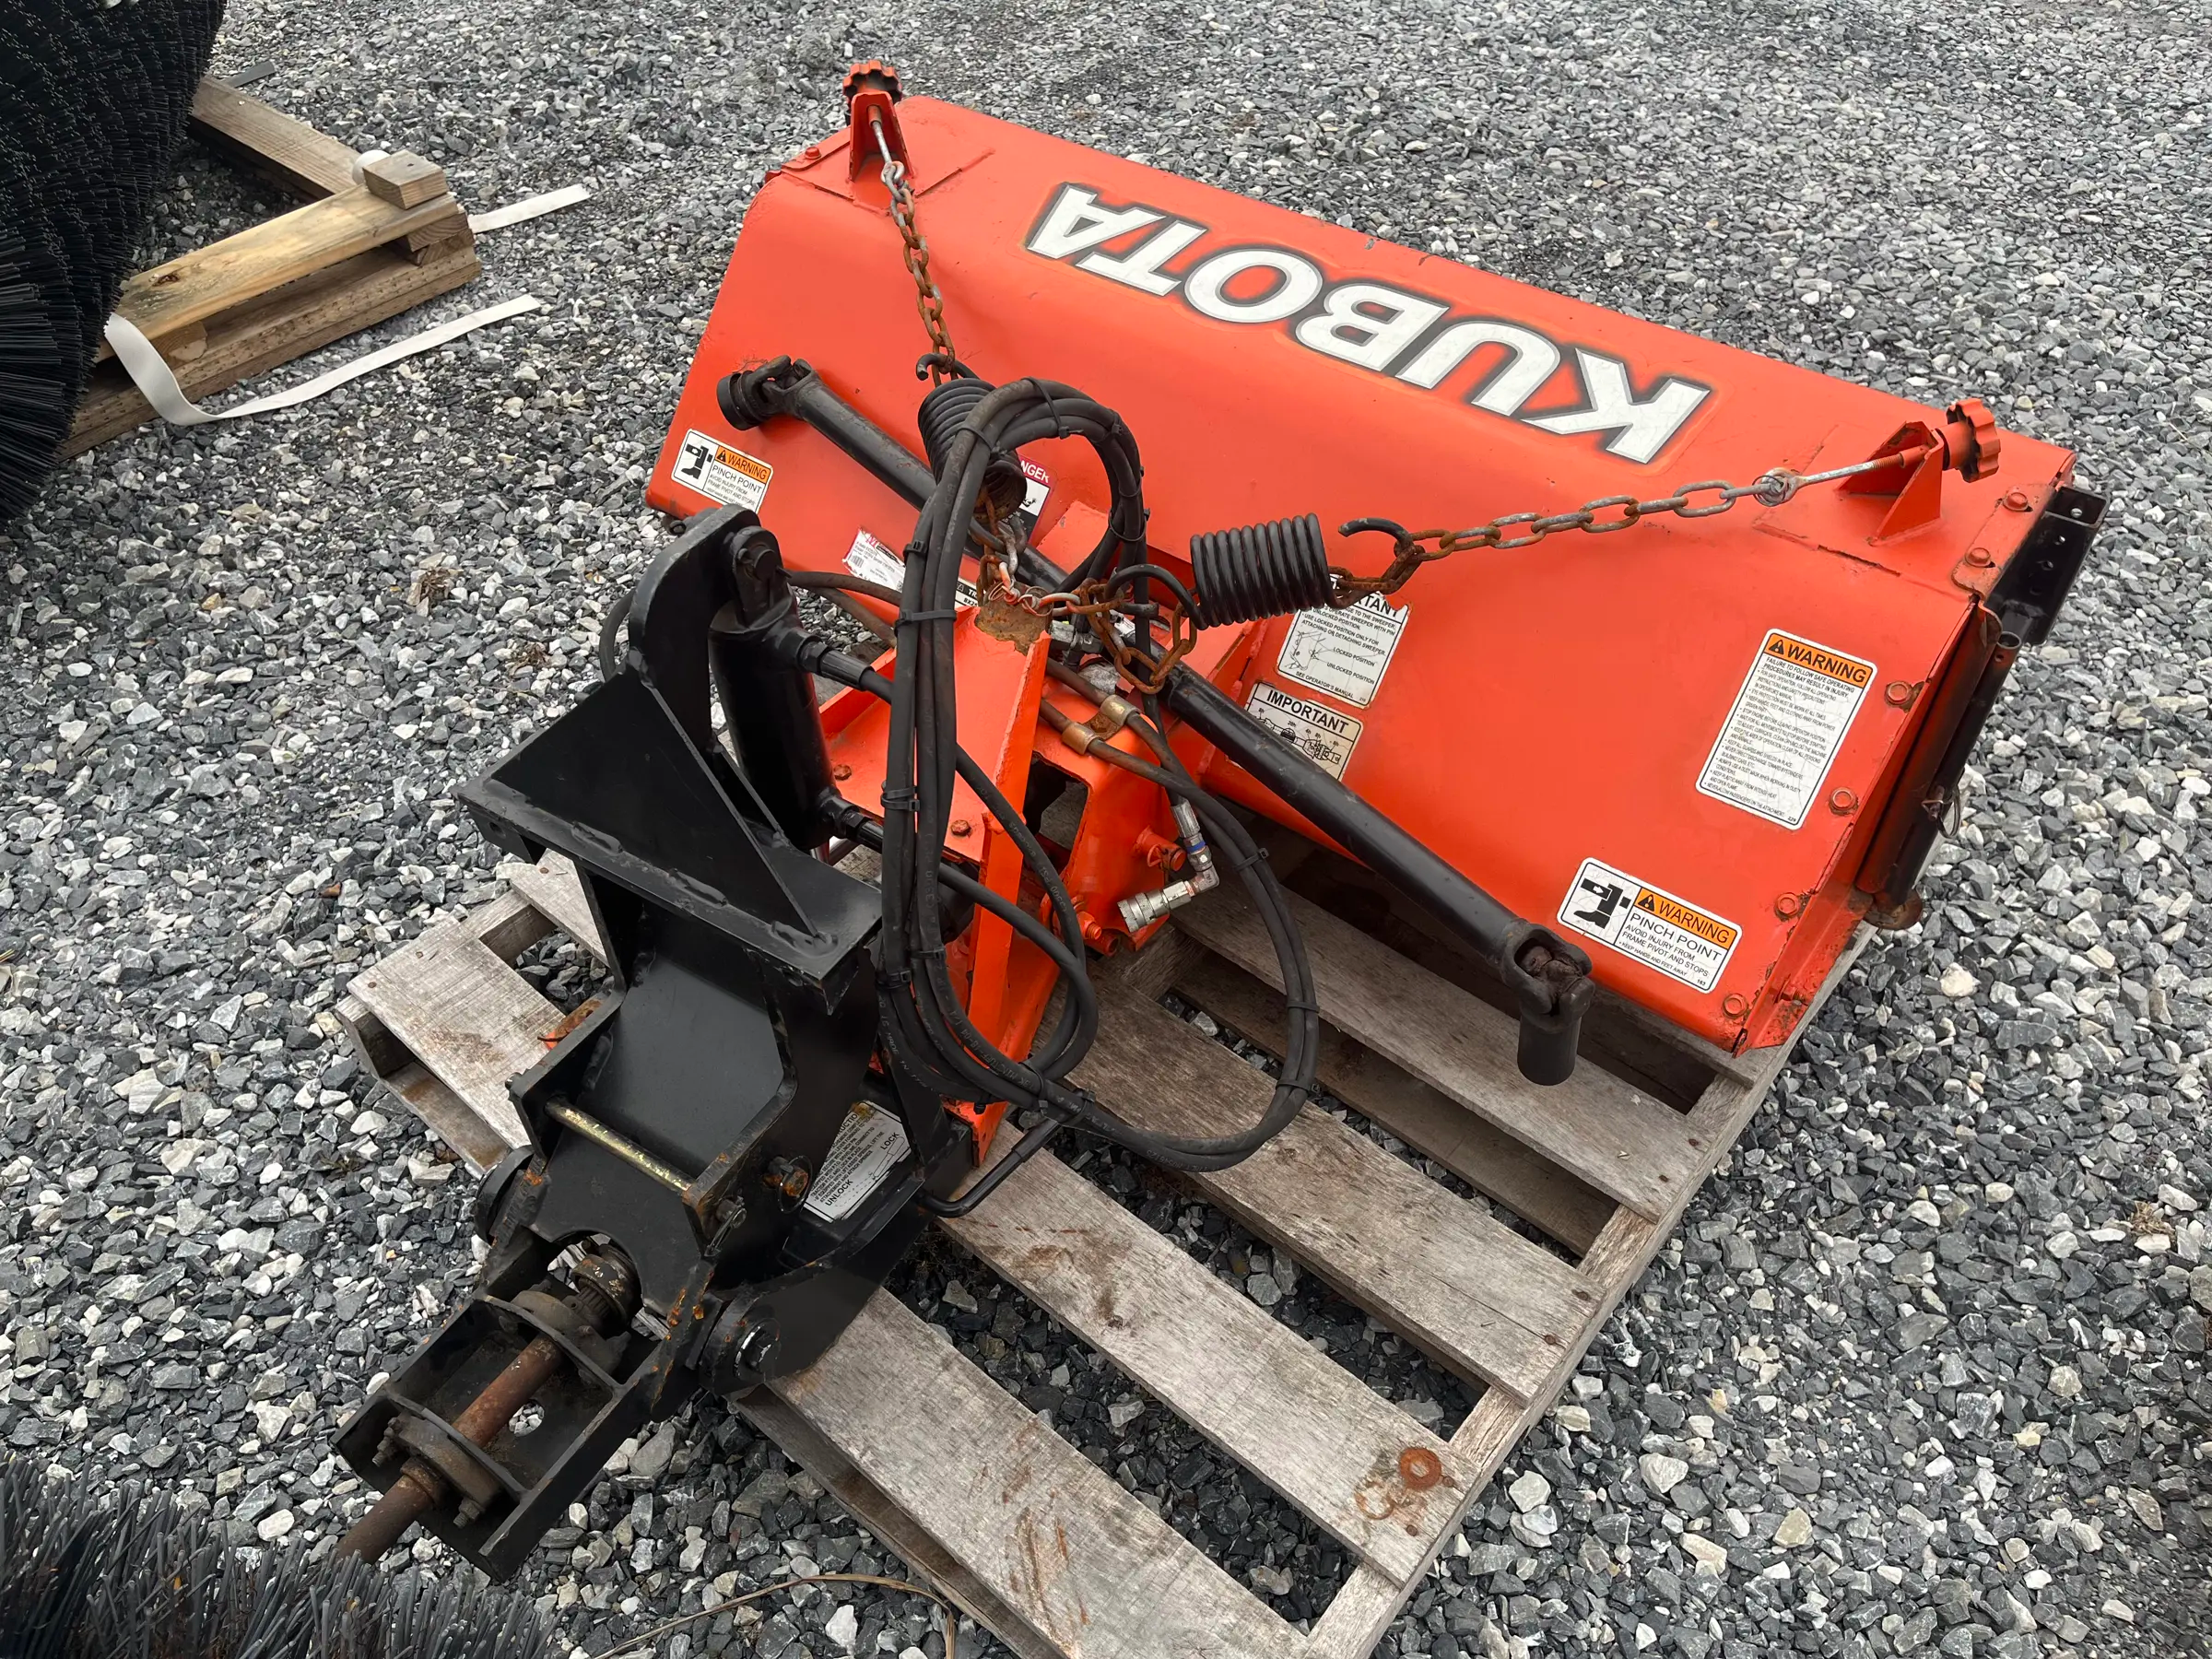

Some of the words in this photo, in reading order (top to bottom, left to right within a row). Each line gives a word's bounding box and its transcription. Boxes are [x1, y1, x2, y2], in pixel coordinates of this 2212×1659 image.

[1024, 182, 1712, 465] KUBOTA
[711, 464, 737, 482] PINCH
[736, 476, 762, 494] POINT
[725, 453, 768, 480] WARNING
[1018, 459, 1052, 483] NGER
[1312, 606, 1338, 621] UNLOCKED
[1349, 615, 1374, 628] SWEEPER
[1373, 623, 1386, 632] WITH
[1353, 608, 1361, 617] TO
[1361, 612, 1371, 620] THE
[1300, 618, 1327, 632] ATTACHING
[1326, 628, 1335, 636] OR
[1334, 631, 1361, 646] DETACHING
[1313, 616, 1334, 629] LOCKED
[1333, 624, 1356, 637] POSITION
[1355, 632, 1369, 641] ONLY
[1368, 638, 1379, 646] FOR
[1332, 646, 1353, 658] LOCKED
[1351, 653, 1375, 667] POSITION
[1784, 642, 1868, 684] WARNING
[1295, 670, 1305, 678] SEE
[1334, 686, 1354, 699] MANUAL
[1325, 661, 1352, 676] UNLOCKED
[1351, 671, 1375, 685] POSITION
[1762, 662, 1795, 679] PROCEDURES
[1794, 674, 1806, 683] MAY
[1805, 677, 1825, 689] RESULT
[1765, 655, 1786, 668] FAILURE
[1793, 665, 1814, 678] FOLLOW
[1812, 673, 1827, 683] SAFE
[1825, 678, 1855, 693] OPERATING
[1265, 688, 1350, 735] IMPORTANT
[1629, 912, 1675, 940] PINCH
[1676, 934, 1722, 962] POINT
[1656, 900, 1731, 945] WARNING
[1621, 930, 1646, 947] FRAME
[1646, 942, 1668, 958] PIVOT
[1667, 952, 1686, 966] AND
[1684, 960, 1709, 977] STOPS
[1624, 923, 1648, 938] AVOID
[1647, 934, 1674, 951] INJURY
[1673, 946, 1695, 961] FROM
[1620, 941, 1634, 951] KEEP
[1633, 947, 1651, 959] HANDS
[1650, 955, 1661, 964] AND
[1659, 960, 1673, 970] FEET
[1671, 966, 1687, 977] AWAY
[879, 1131, 900, 1150] LOCK
[824, 1178, 853, 1206] UNLOCK
